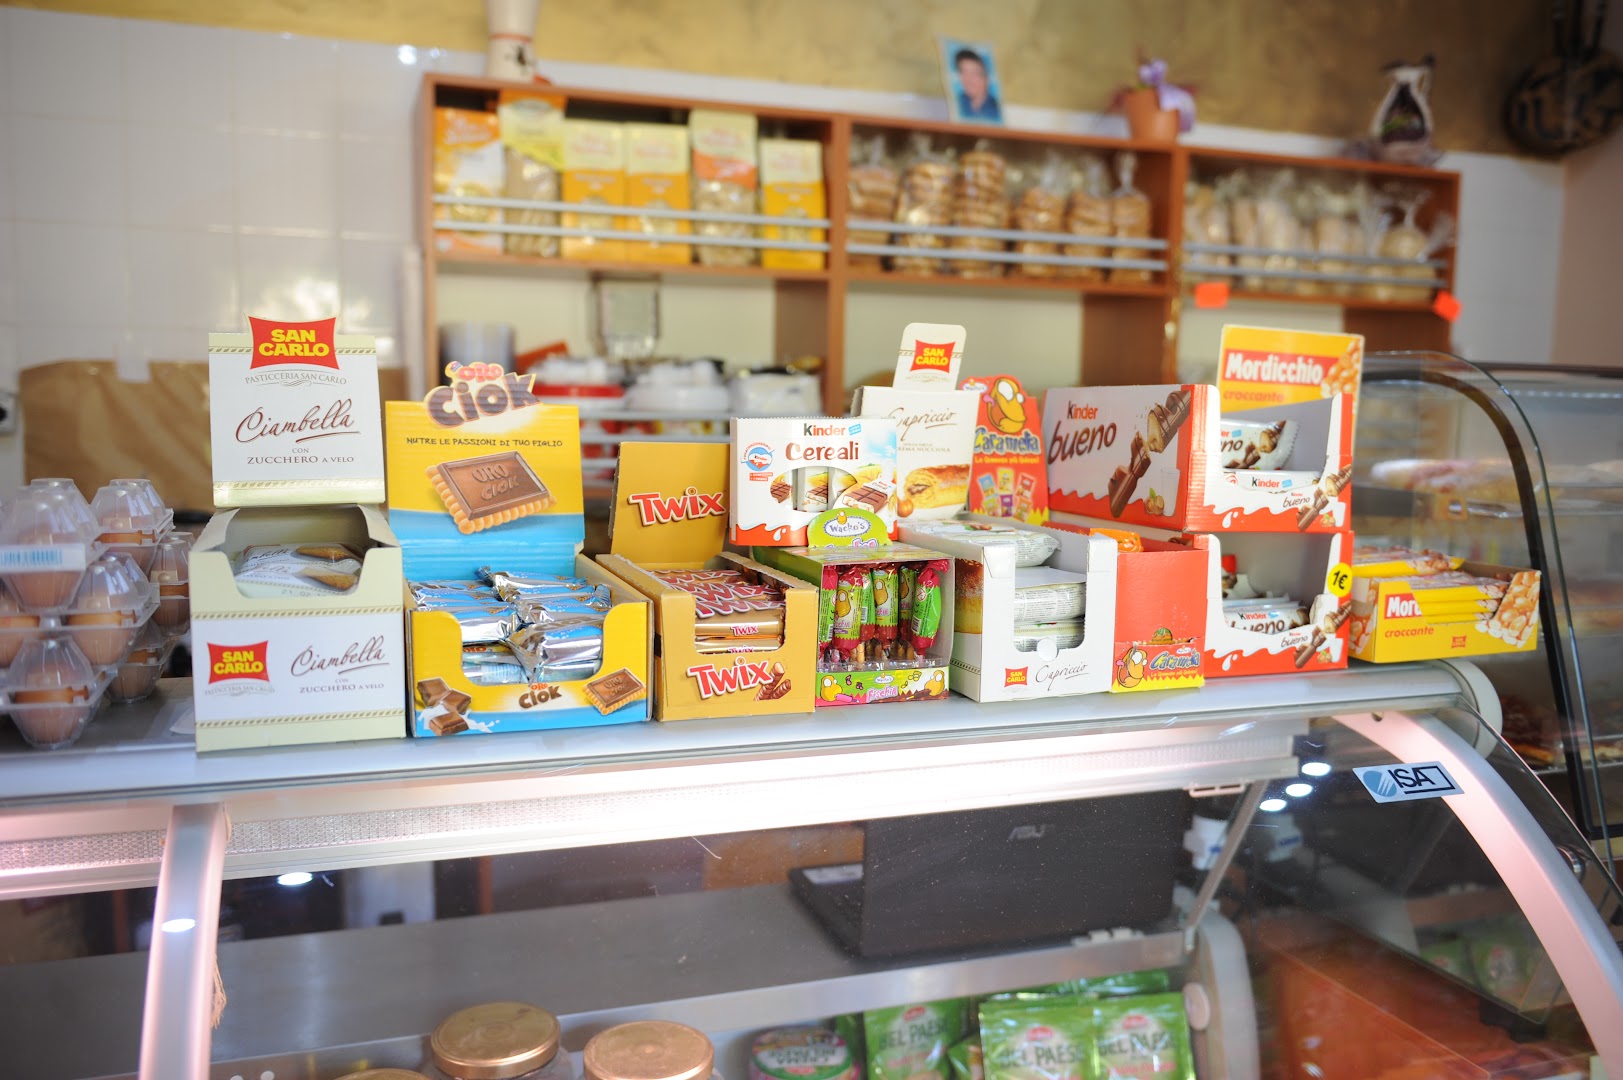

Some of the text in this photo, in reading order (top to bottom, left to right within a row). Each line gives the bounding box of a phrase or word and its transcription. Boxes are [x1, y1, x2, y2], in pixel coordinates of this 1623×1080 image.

[271, 329, 316, 342] SAN
[258, 343, 330, 357] CARLO
[922, 348, 945, 357] SAN
[915, 356, 949, 366] CARLO
[456, 363, 504, 383] ORO
[1224, 352, 1323, 385] Mordicchio
[245, 372, 347, 385] PASTICCERIA SAN CARLO
[235, 398, 356, 443] Ciambella
[406, 437, 437, 445] NUTRE
[453, 438, 496, 446] PASSIONI
[1047, 420, 1117, 465] bueno
[785, 441, 859, 461] Cereali
[247, 455, 319, 465] ZUCCHERO
[1283, 497, 1310, 507] bueno
[1333, 571, 1348, 590] 1€
[1384, 626, 1435, 638] croccante
[1281, 636, 1308, 647] bueno
[222, 650, 254, 663] SAN
[290, 635, 386, 677] Ciambella
[213, 661, 264, 675] CARLO
[1035, 662, 1088, 692] Capriccio
[299, 684, 356, 693] ZUCCHERO
[1387, 765, 1436, 788] ISA
